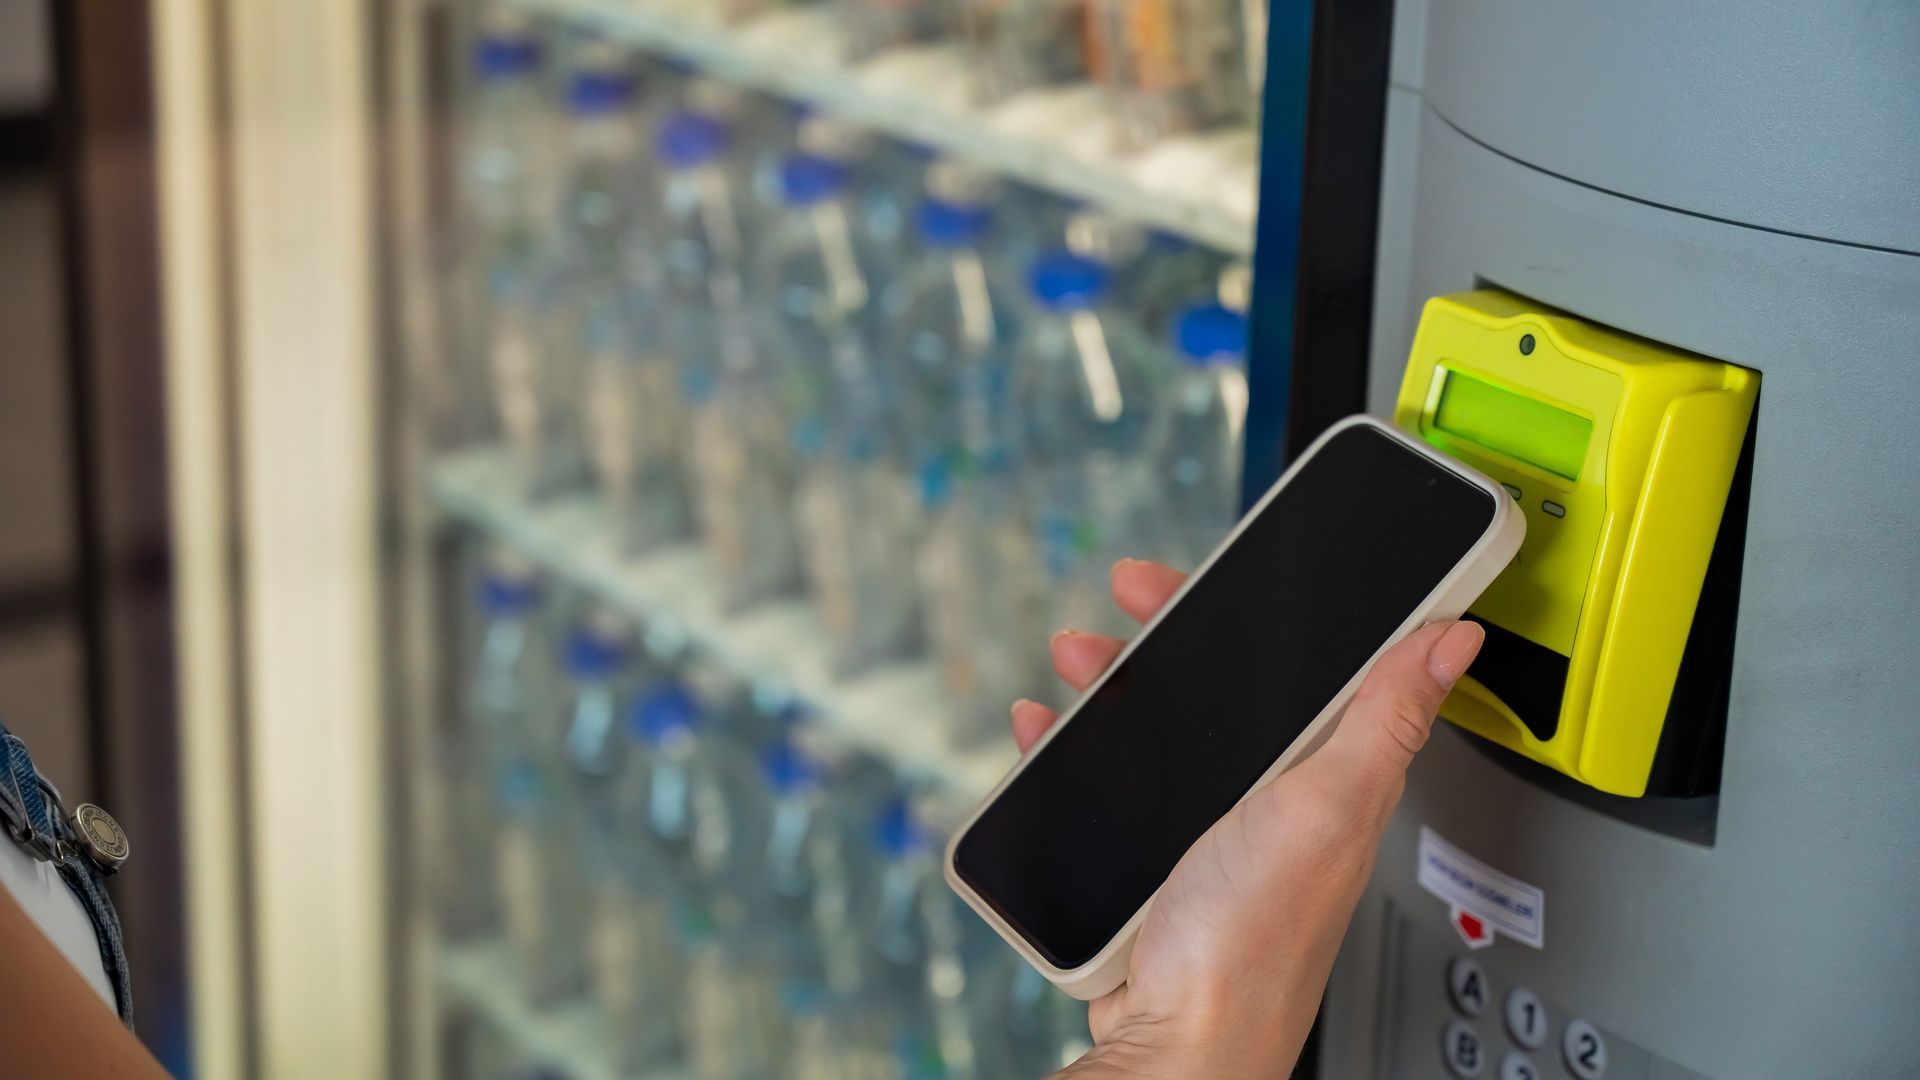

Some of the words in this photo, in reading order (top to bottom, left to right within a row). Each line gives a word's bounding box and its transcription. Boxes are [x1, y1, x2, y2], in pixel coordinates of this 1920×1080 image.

[1462, 970, 1483, 1007] A
[1524, 1003, 1536, 1036] 1
[1457, 1032, 1478, 1068] B
[1578, 1034, 1598, 1071] 2
